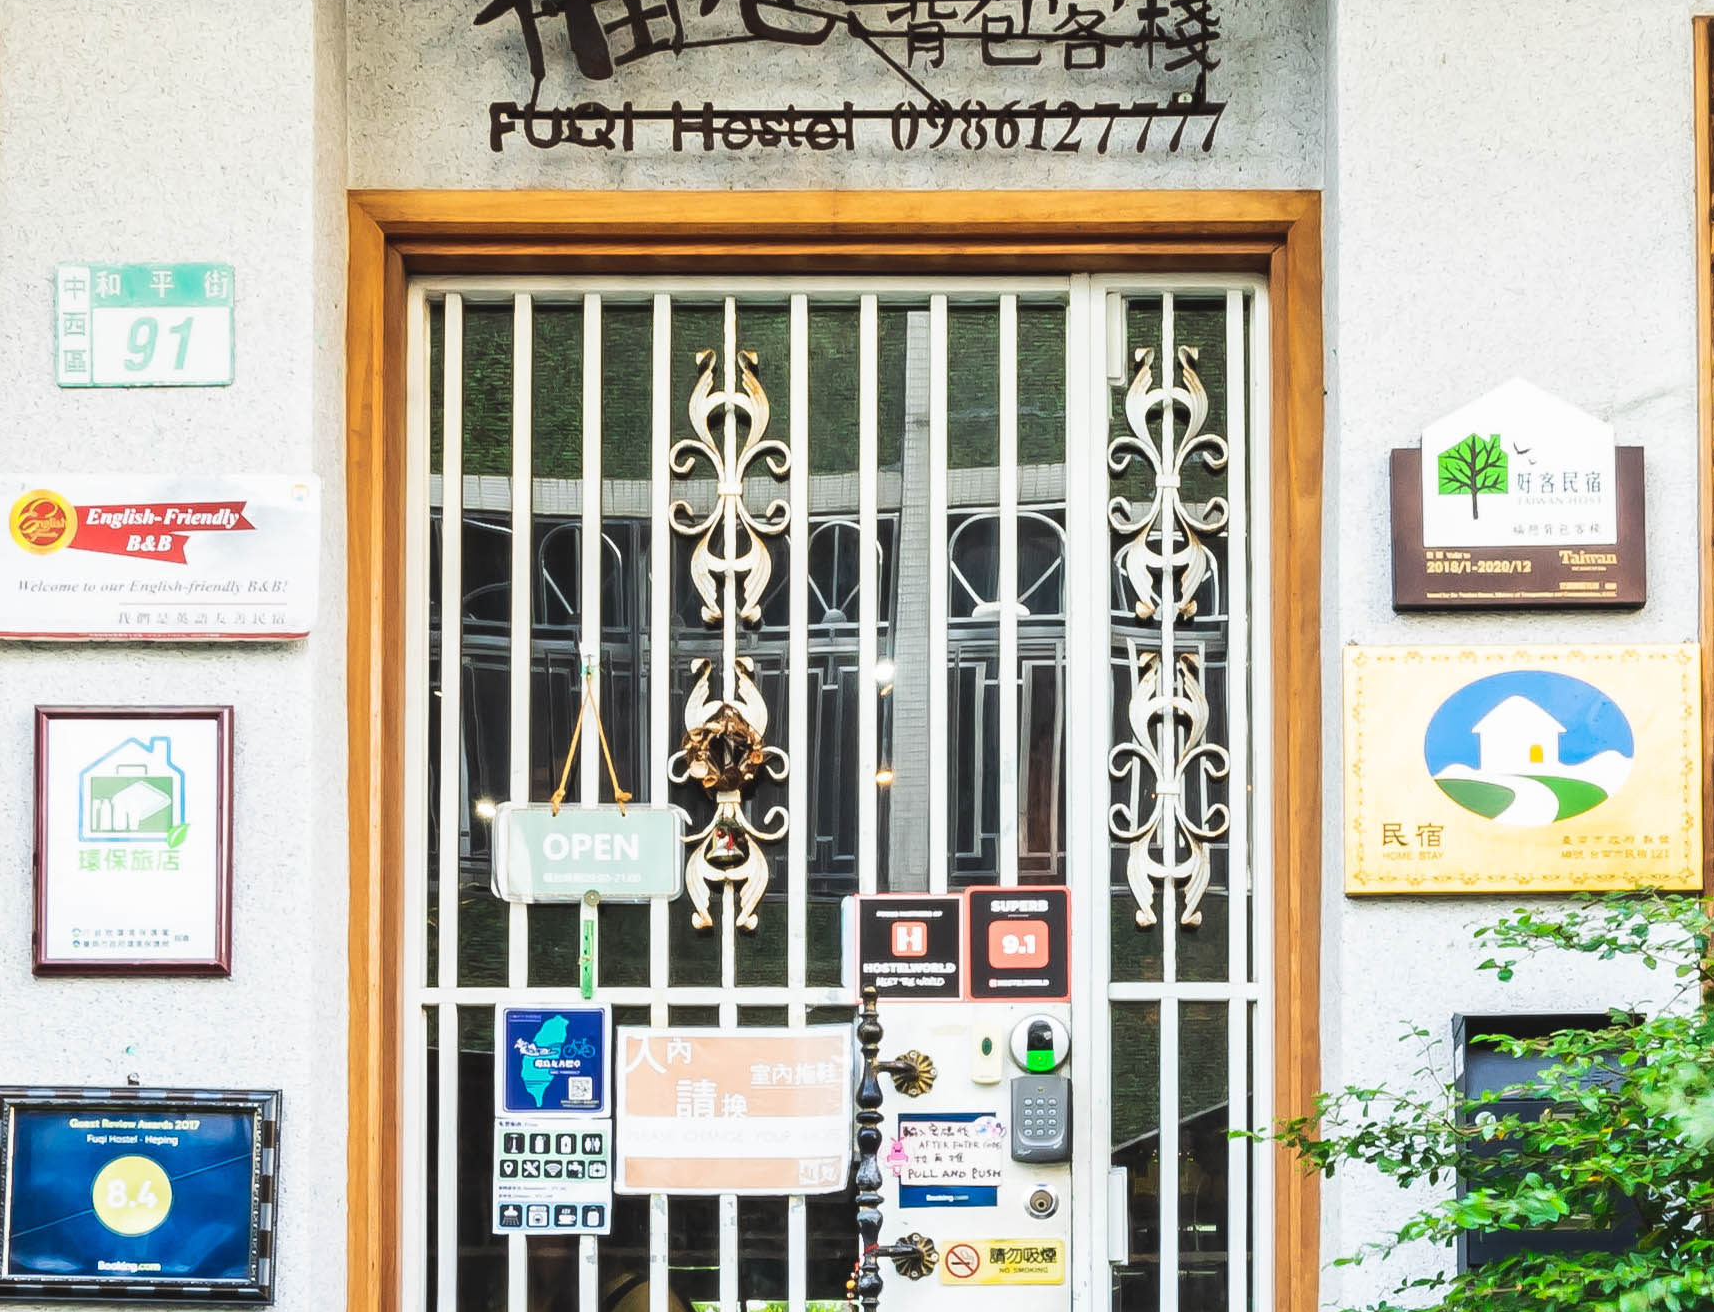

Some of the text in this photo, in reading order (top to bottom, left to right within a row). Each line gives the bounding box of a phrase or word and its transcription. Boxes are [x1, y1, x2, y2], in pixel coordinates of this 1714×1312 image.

[488, 100, 1227, 155] FUQI Hostel 0986127777
[96, 270, 229, 298] 和平街
[63, 276, 87, 373] 中西區
[124, 316, 195, 371] 91
[1517, 471, 1601, 495] 好客民宿
[86, 508, 239, 530] English-Friendly
[126, 534, 172, 552] B&B
[1426, 560, 1532, 575] 2018/1-2020/12
[1559, 550, 1617, 566] Taiwan
[18, 580, 79, 594] Welcome
[83, 581, 95, 594] to
[100, 583, 125, 594] our
[129, 579, 241, 597] English-friendly
[1382, 822, 1445, 848] 民宿
[543, 833, 639, 860] OPEN
[1382, 850, 1445, 861] HOME STAY
[78, 849, 180, 872] 環保旅店
[990, 900, 1049, 912] SUPERB
[896, 926, 923, 951] H
[1002, 934, 1037, 955] 9.1
[863, 962, 956, 974] HOSTELWORLD
[675, 1079, 748, 1121] 請換
[69, 1117, 100, 1130] Guest
[101, 1118, 137, 1130] Review
[138, 1119, 173, 1131] Awards
[108, 1134, 138, 1144] Hostel
[918, 1140, 949, 1150] AFTER
[908, 1168, 1002, 1180] PULL AND PUSH
[105, 1178, 159, 1209] 8.4
[989, 1247, 1057, 1265] 請勿吸煙
[97, 1260, 162, 1273] Booking.com
